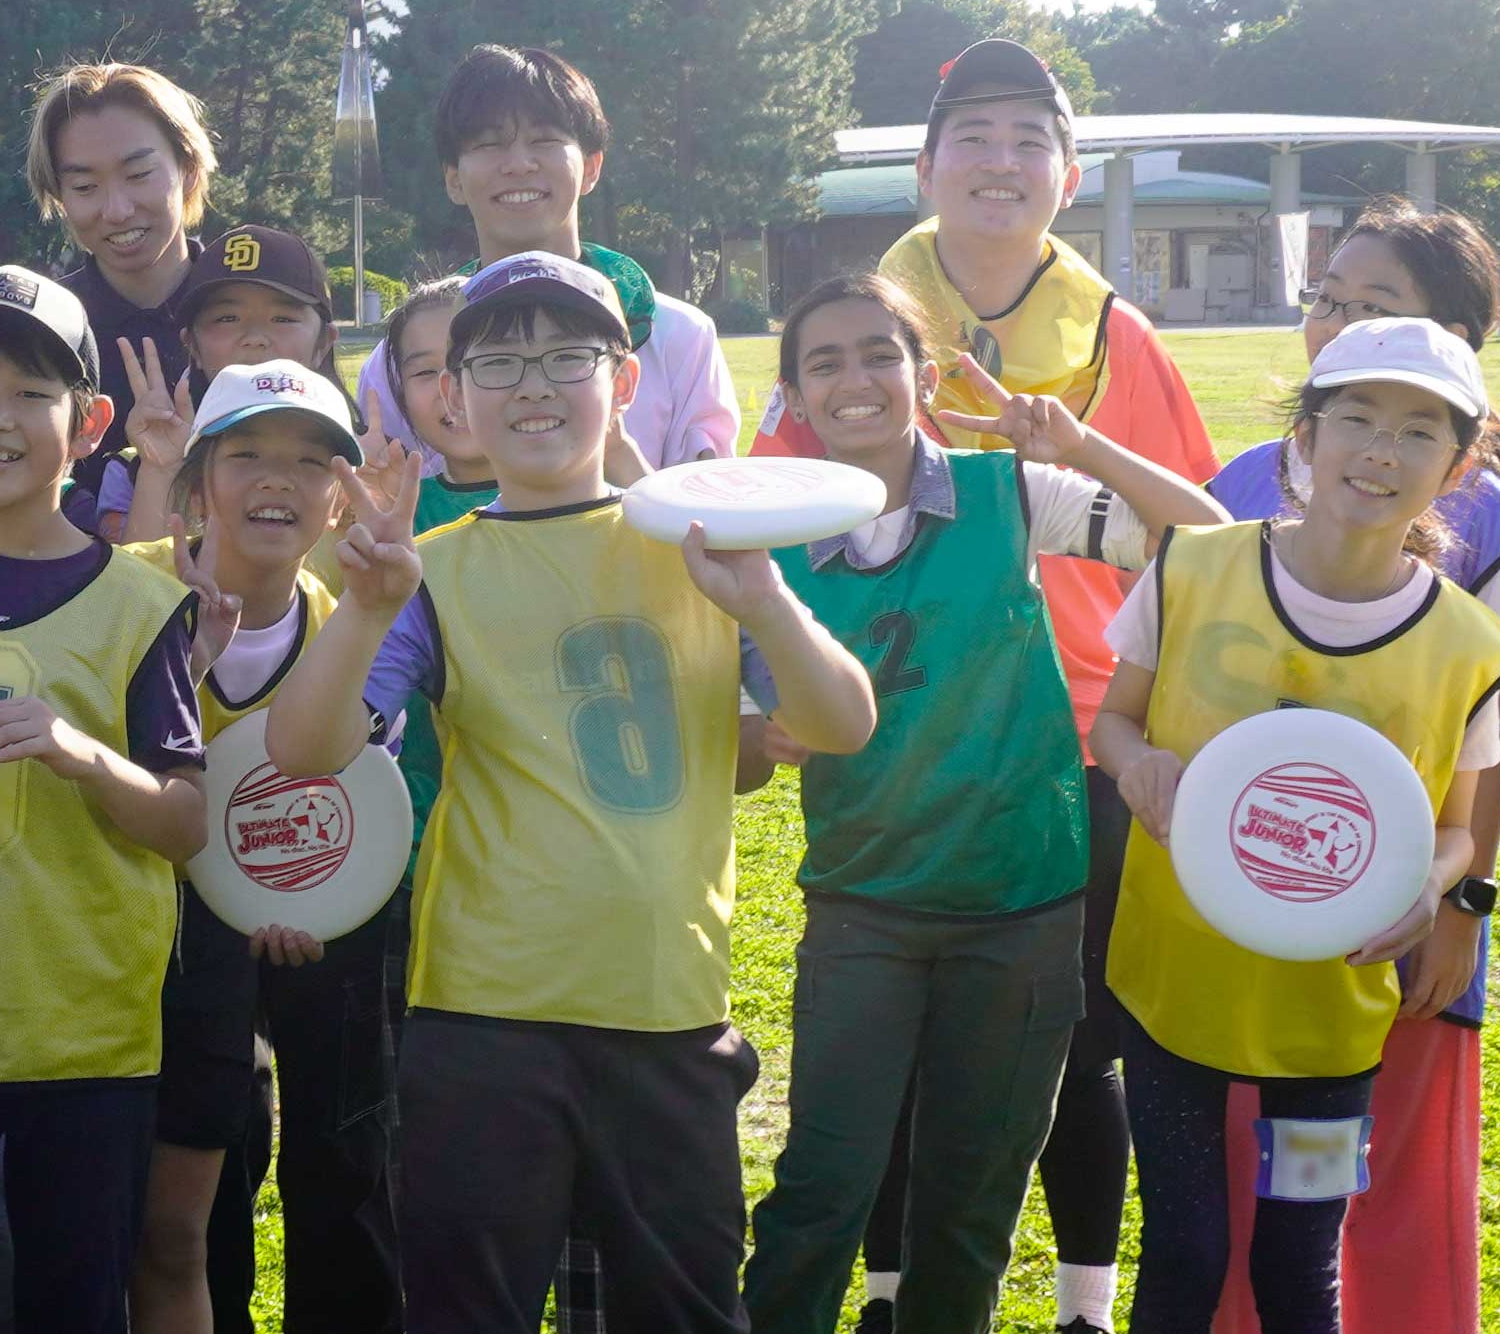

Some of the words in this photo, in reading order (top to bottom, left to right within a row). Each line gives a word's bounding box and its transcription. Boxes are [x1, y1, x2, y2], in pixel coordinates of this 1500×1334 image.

[223, 234, 261, 272] SD
[868, 608, 929, 698] 2
[1238, 816, 1309, 854] JUNIOR
[1248, 803, 1306, 834] ULTIMATE
[238, 828, 299, 855] JUNIOR
